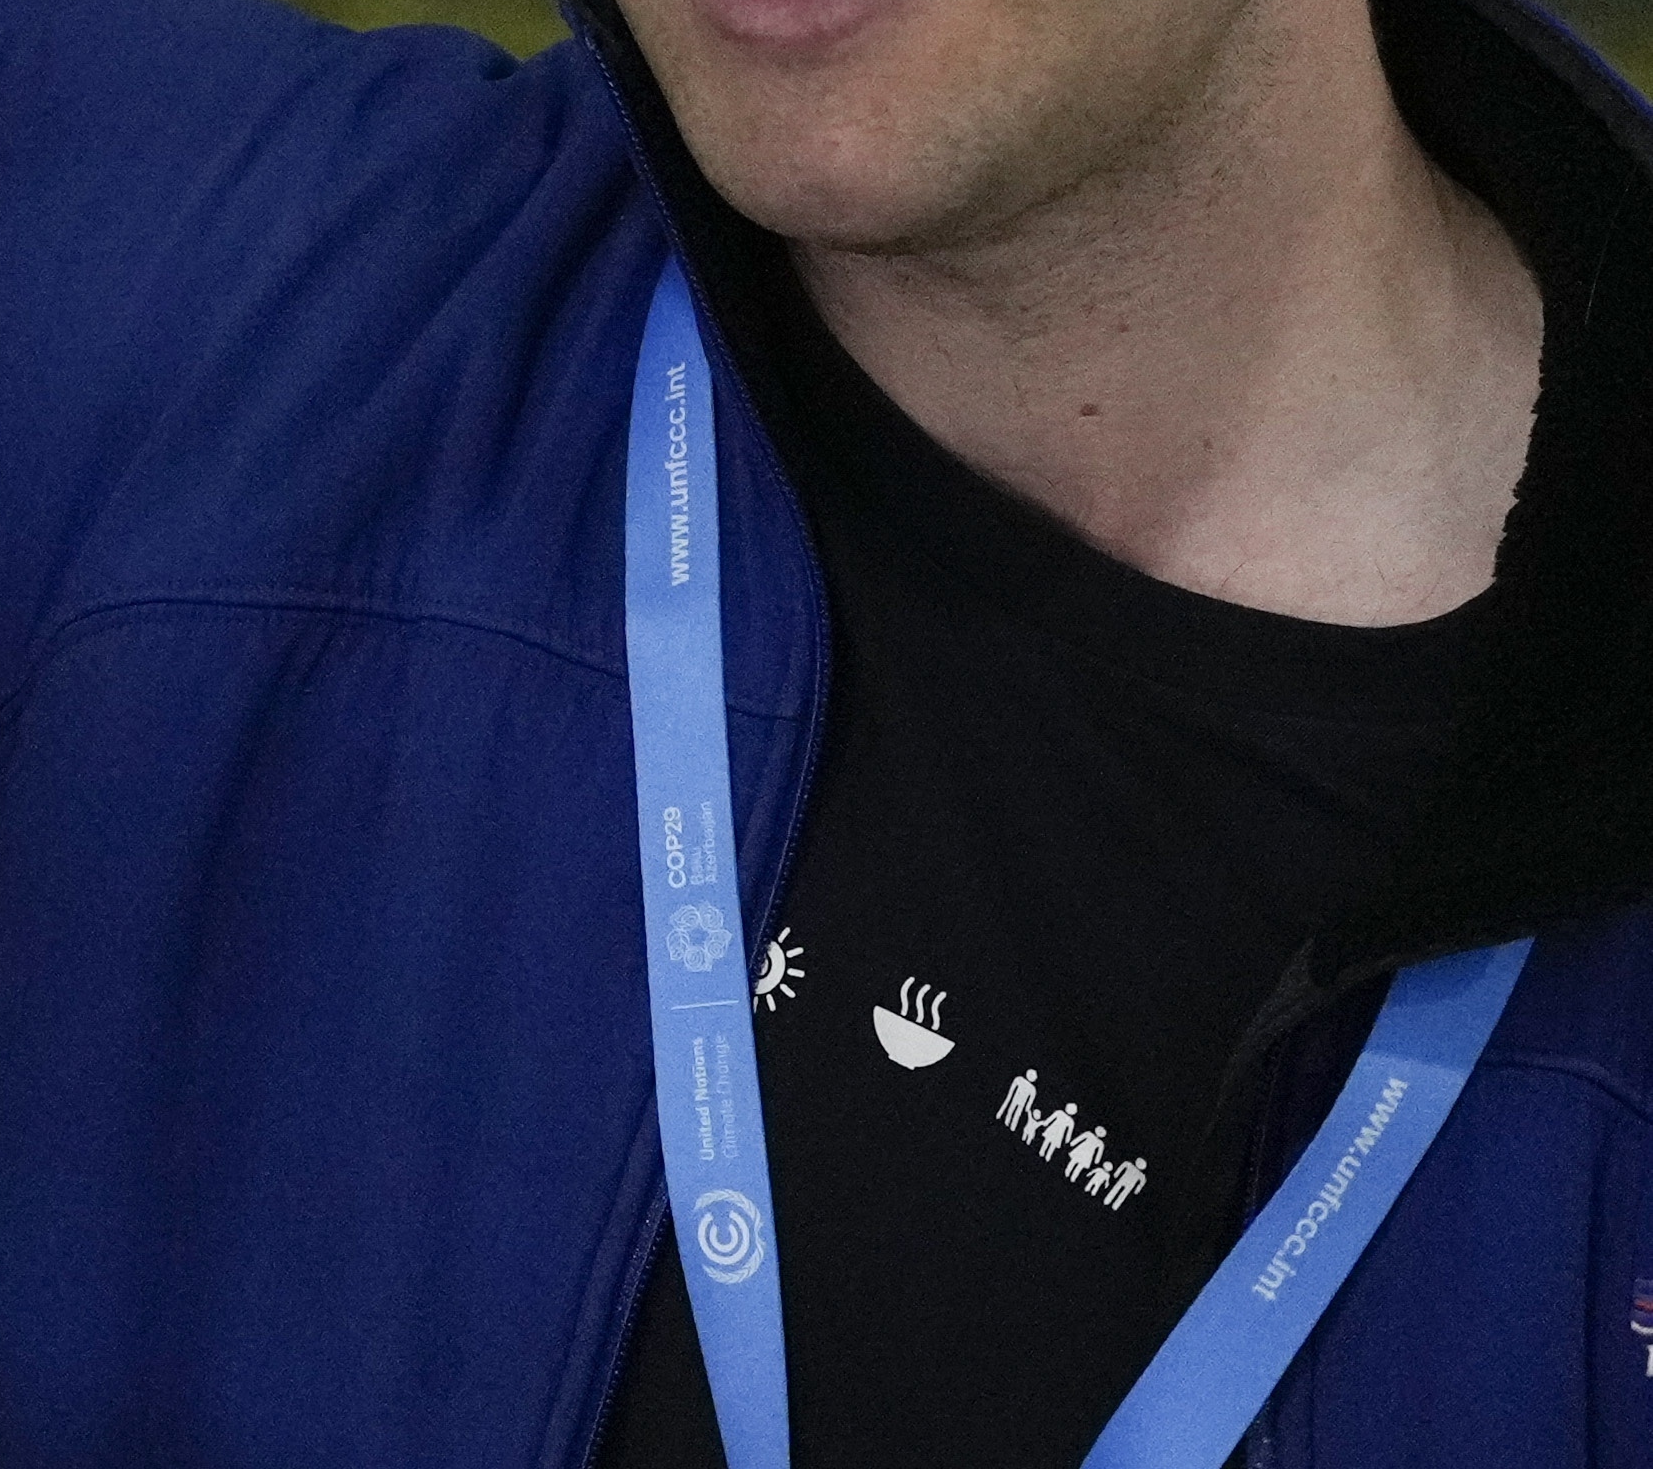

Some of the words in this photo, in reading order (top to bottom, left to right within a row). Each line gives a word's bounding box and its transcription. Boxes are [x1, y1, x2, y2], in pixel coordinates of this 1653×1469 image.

[664, 361, 690, 587] www.unfccc.int
[663, 806, 687, 889] COP29
[692, 1036, 710, 1101] Nations
[695, 1106, 715, 1161] United
[1251, 1077, 1409, 1302] www.unfccc.int
